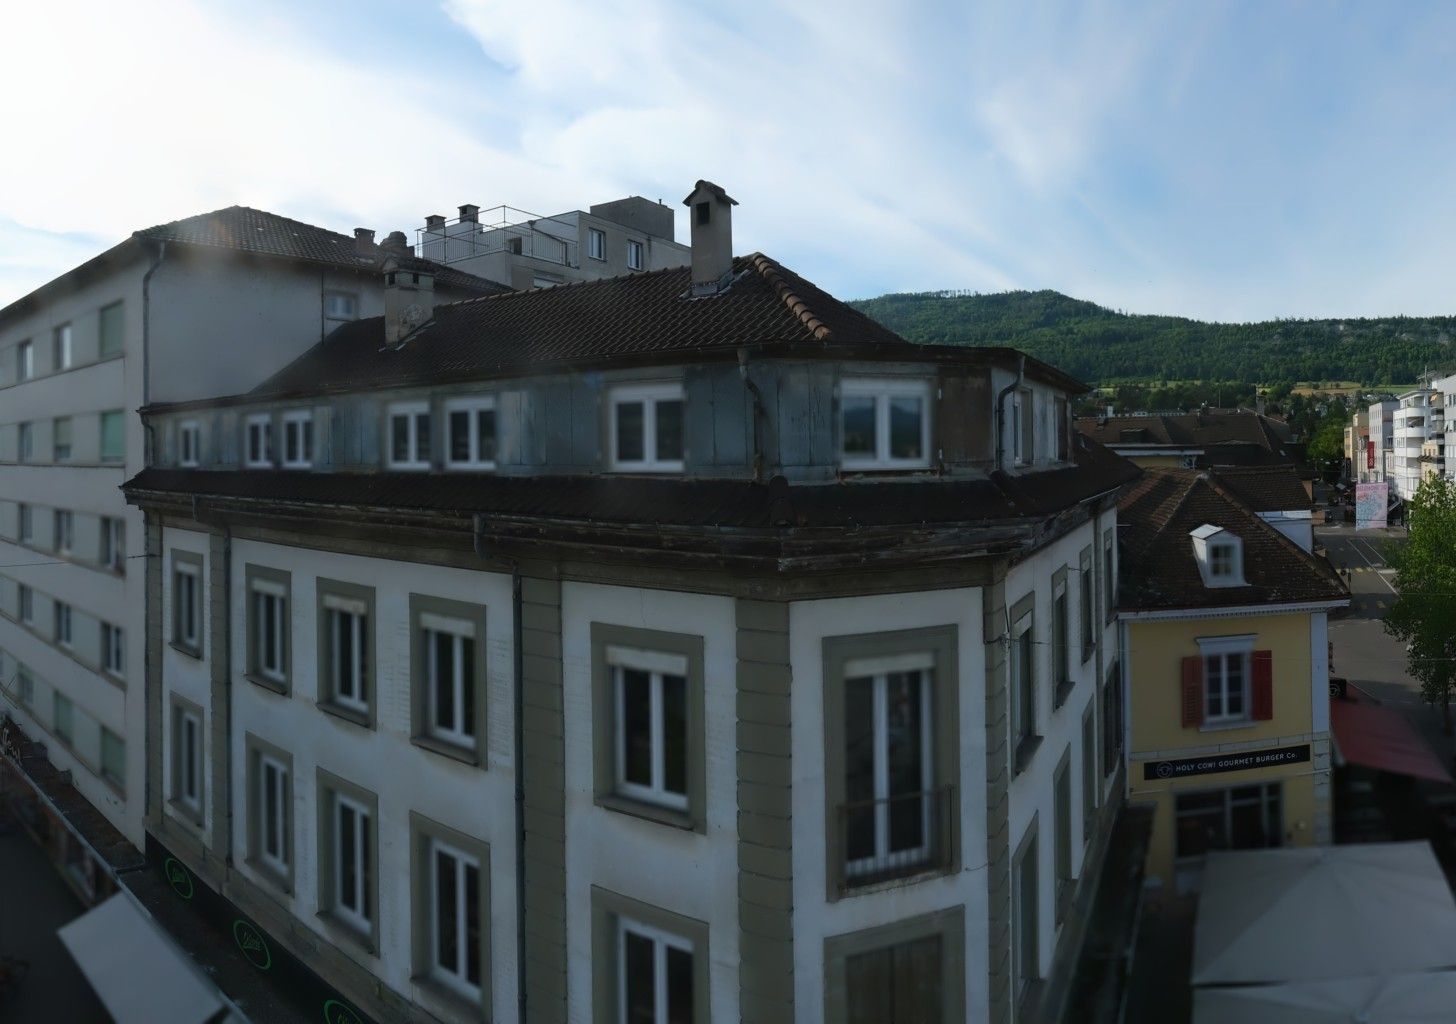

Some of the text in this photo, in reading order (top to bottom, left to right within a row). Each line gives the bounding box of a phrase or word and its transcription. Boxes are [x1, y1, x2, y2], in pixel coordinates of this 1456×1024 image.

[1176, 763, 1195, 772] HOLY
[1197, 761, 1217, 770] COW!
[1218, 757, 1254, 768] GOURMET
[1255, 753, 1285, 763] BURGER
